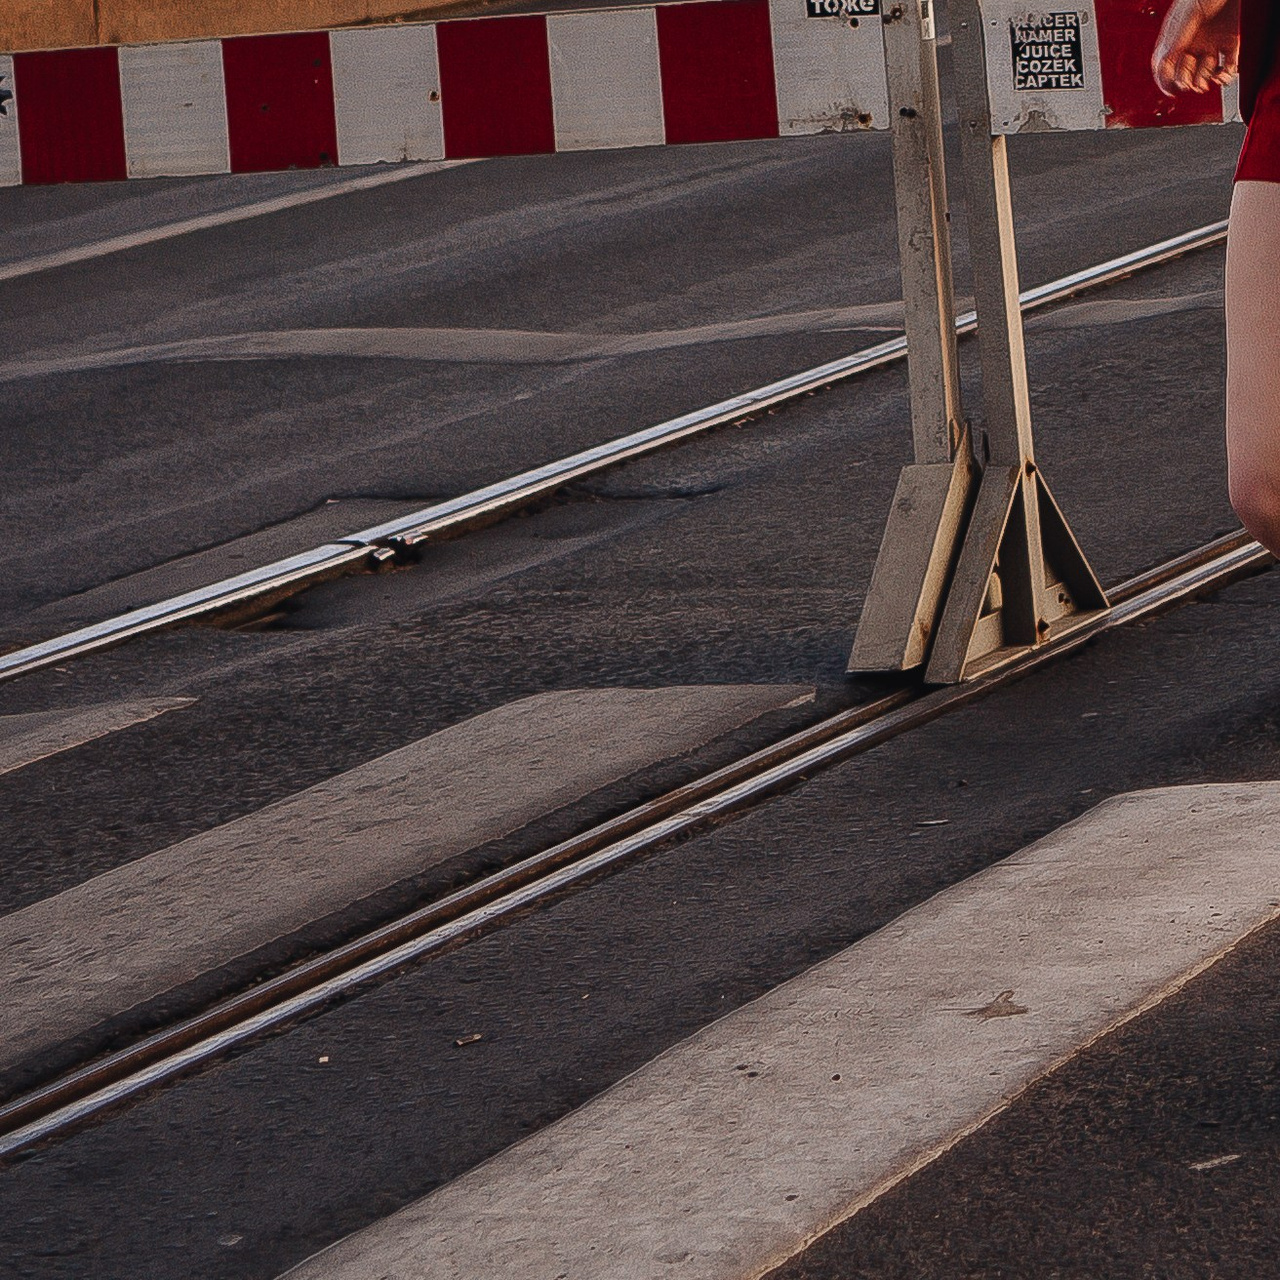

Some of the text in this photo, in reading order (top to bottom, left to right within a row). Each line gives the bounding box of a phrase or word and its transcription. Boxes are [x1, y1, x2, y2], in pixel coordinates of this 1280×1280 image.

[1020, 44, 1073, 58] JUICE
[1018, 59, 1077, 73] COZEK
[1015, 73, 1084, 88] CAPTEK
